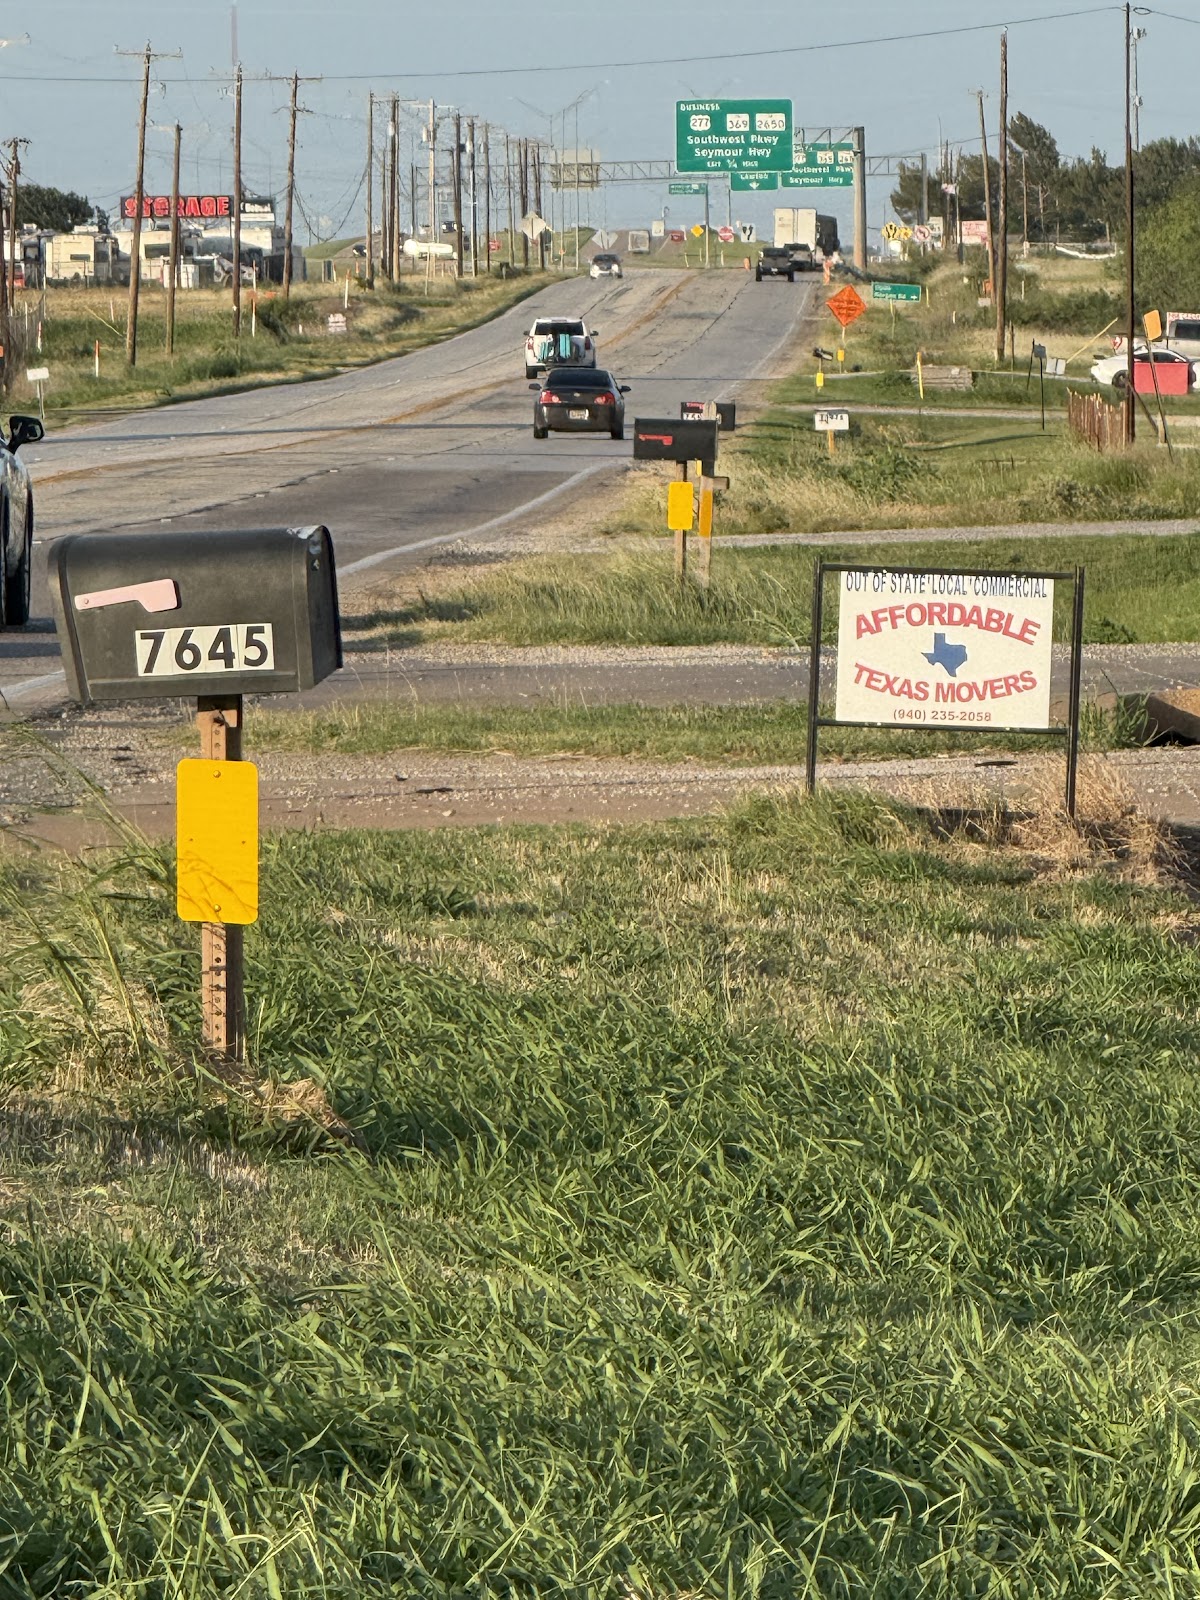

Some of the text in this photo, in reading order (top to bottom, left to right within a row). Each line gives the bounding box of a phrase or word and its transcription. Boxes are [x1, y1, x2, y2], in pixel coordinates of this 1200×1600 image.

[691, 118, 784, 129] 277 369 2650
[687, 135, 779, 145] Southwest Pkwy
[694, 148, 771, 158] Seymour Hwy
[846, 572, 869, 591] OUT
[873, 573, 887, 592] OF
[974, 576, 1047, 598] COMMERCIAL
[856, 602, 1041, 646] AFFORDABLE
[140, 626, 268, 674] 7645
[854, 662, 1037, 703] TEXAS MOVERS
[893, 709, 992, 722] (940) 235-2058
